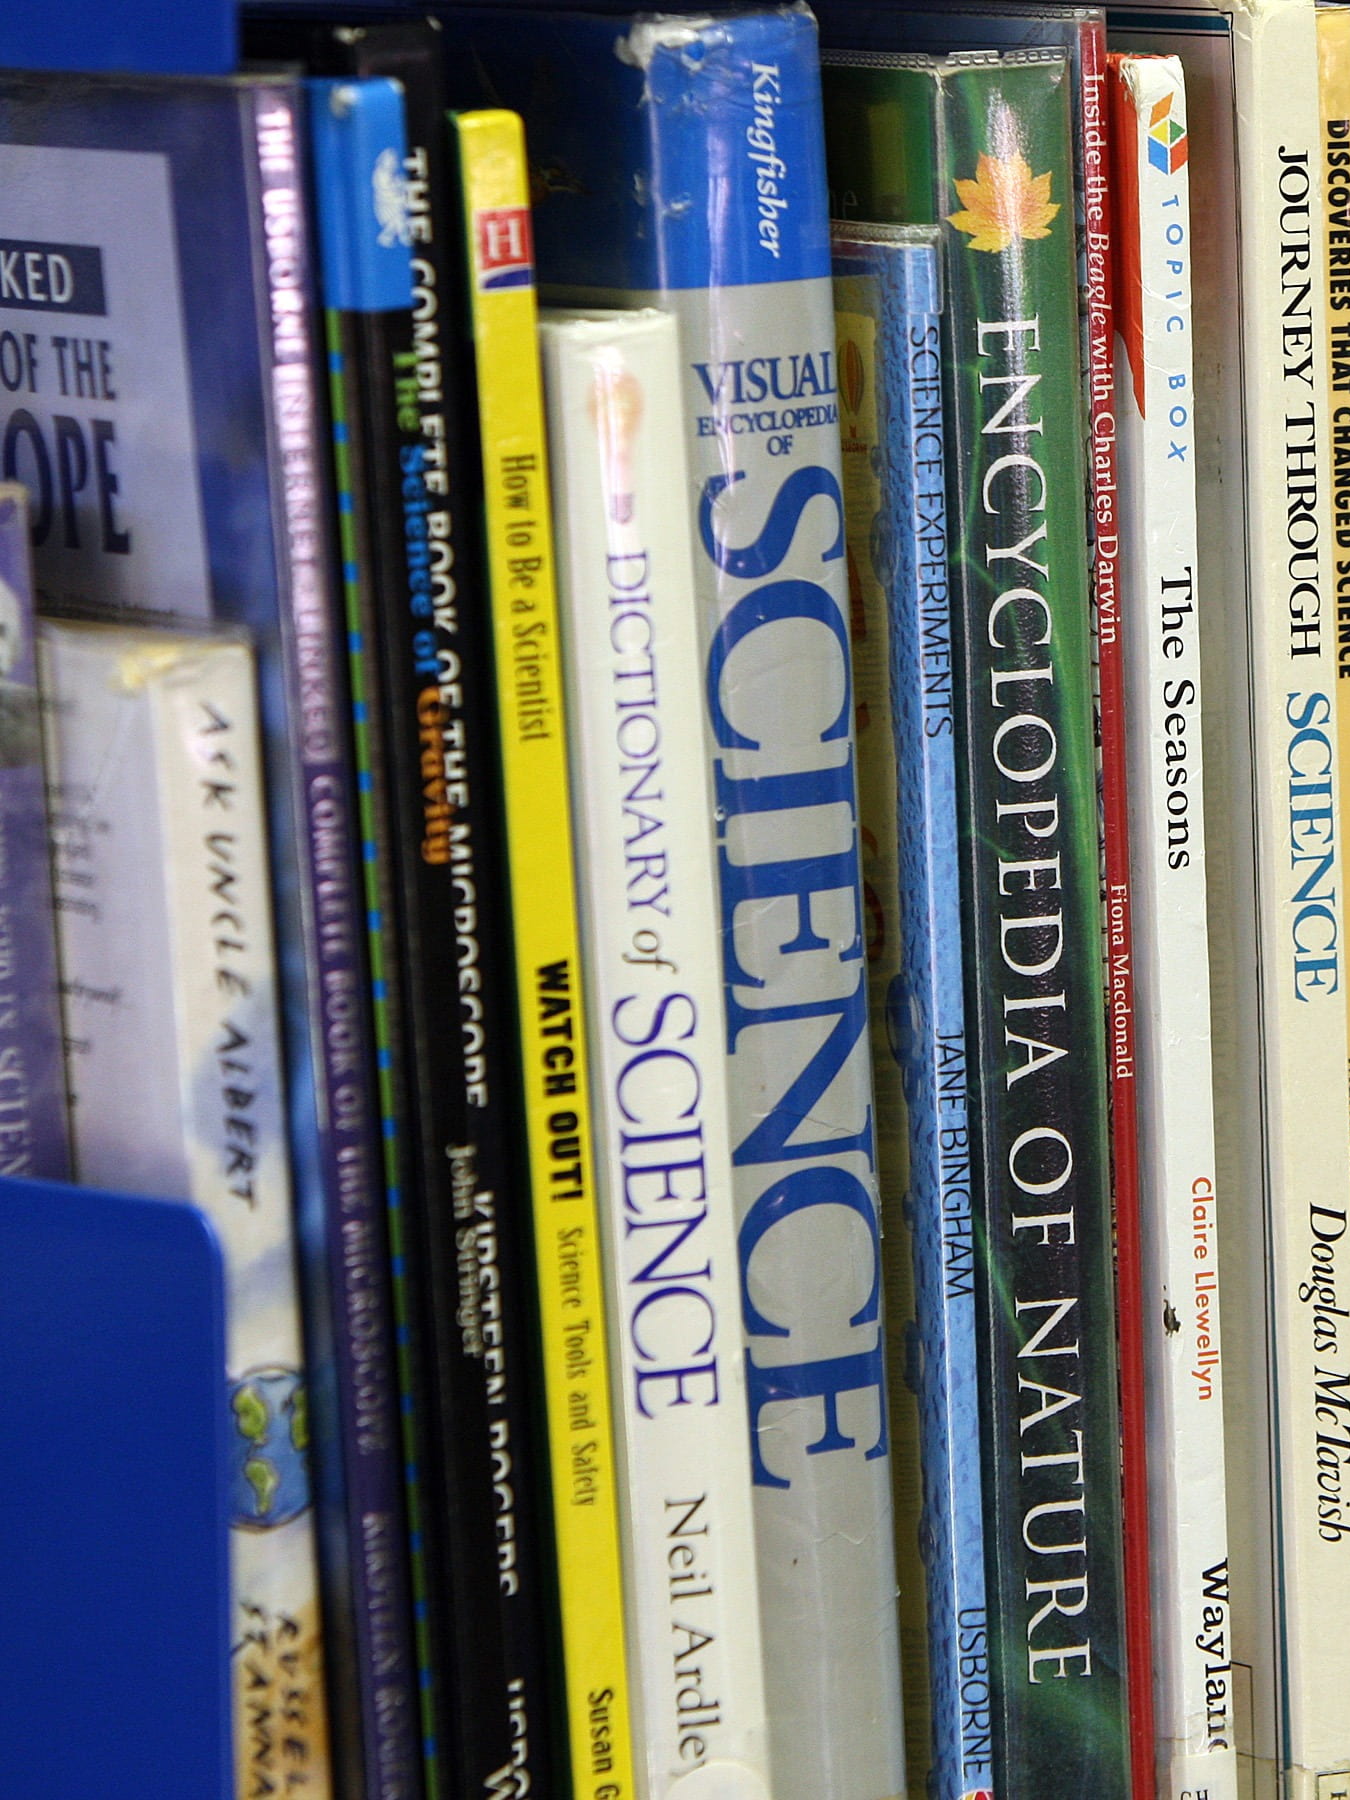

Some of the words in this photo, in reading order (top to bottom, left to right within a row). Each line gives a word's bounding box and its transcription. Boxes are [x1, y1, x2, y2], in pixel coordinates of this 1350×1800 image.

[746, 62, 787, 260] Kingfisher
[1083, 73, 1108, 165] Inside
[1089, 175, 1111, 221] the
[1084, 231, 1112, 326] Beagle
[1161, 194, 1186, 334] TOPIC
[1277, 145, 1315, 390] JOURNEY
[0, 329, 39, 393] OF
[52, 336, 118, 402] THE
[692, 350, 838, 405] VISUAL
[696, 404, 838, 438] ENCYCLOPEDIA
[909, 325, 943, 477] SCIENCE
[1089, 335, 1113, 402] with
[1166, 373, 1189, 463] BOX
[500, 453, 538, 512] How
[766, 434, 794, 457] OF
[1092, 411, 1117, 524] Charles
[401, 444, 434, 620] Science
[506, 519, 532, 547] to
[508, 554, 543, 588] Be
[1283, 401, 1322, 661] THROUGH
[510, 598, 530, 615] a
[914, 491, 953, 739] EXPERIMENTS
[1095, 533, 1119, 645] Darwin
[1160, 566, 1193, 660] The
[413, 631, 441, 677] of
[512, 621, 551, 744] Scientist
[976, 313, 1070, 1093] ENCYCLOPEDIA
[416, 685, 451, 866] Gravity
[606, 552, 674, 918] DICTIONARY
[1162, 679, 1198, 872] Seasons
[308, 774, 352, 957] COMPLETE
[1285, 691, 1339, 1003] SCIENCE
[203, 832, 252, 997] UNCLE
[621, 929, 678, 975] of
[1110, 883, 1129, 947] Fiona
[323, 970, 363, 1074] BOOK
[535, 959, 577, 1098] WATCH
[699, 466, 889, 1490] SCIENCE
[1112, 953, 1134, 1080] Macdonald
[216, 1021, 261, 1213] ALBERT
[333, 1085, 366, 1132] OF
[934, 1027, 968, 1115] JANE
[336, 1145, 372, 1211] THE
[547, 1110, 585, 1202] OUT!
[611, 992, 721, 1420] SCIENCE
[1008, 1126, 1076, 1247] OF
[558, 1226, 586, 1310] Science
[938, 1126, 976, 1301] BINGHAM
[1191, 1176, 1215, 1261] Claire
[1299, 1202, 1350, 1354] Douglas
[563, 1319, 592, 1382] Tools
[1191, 1271, 1219, 1402] Llewellyn
[569, 1389, 597, 1432] and
[571, 1439, 602, 1508] Safety
[1014, 1295, 1093, 1686] NATURE
[665, 1492, 714, 1606] Neil
[587, 1687, 616, 1777] Susan
[669, 1620, 721, 1774] Ardle
[955, 1606, 993, 1779] USBORNE
